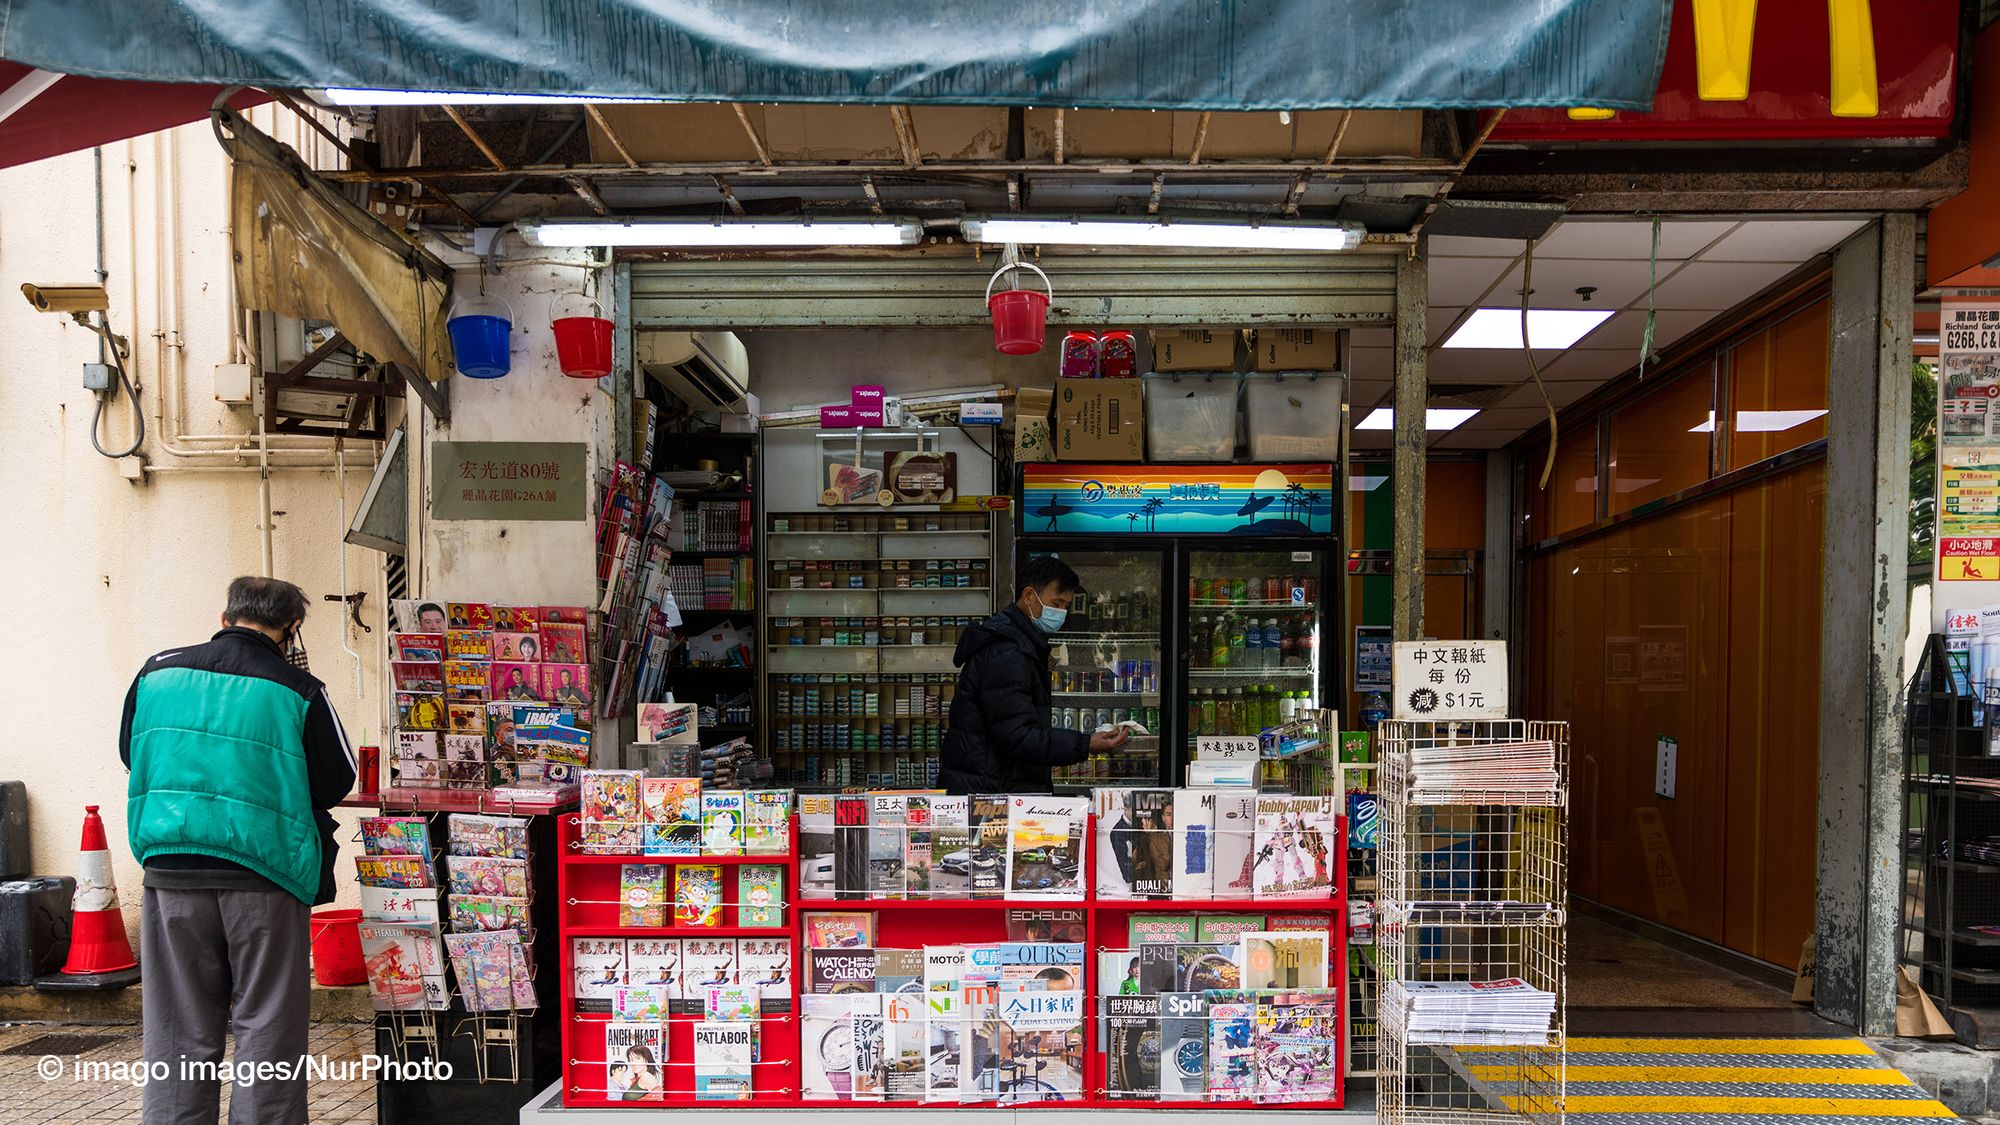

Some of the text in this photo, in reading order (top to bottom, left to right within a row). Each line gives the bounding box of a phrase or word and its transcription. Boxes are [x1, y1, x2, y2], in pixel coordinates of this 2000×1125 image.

[1955, 311, 2000, 321] 麗晶花園
[1981, 332, 1988, 348] C
[1990, 332, 1997, 348] &
[459, 460, 561, 481] 宏光道80號
[1949, 540, 1993, 551] 小心地滑
[1948, 614, 1979, 628] 信報
[1413, 648, 1486, 664] 中文報紙
[1415, 692, 1485, 709] 減 $1元
[399, 734, 424, 742] MIX
[401, 747, 414, 759] 18
[648, 782, 678, 793] 老夫子
[835, 799, 866, 825] HiFi
[1011, 910, 1082, 921] ECHELON
[374, 928, 402, 937] HEALTH
[576, 941, 623, 955] 龍虎門
[631, 941, 678, 955] 龍虎門
[686, 941, 734, 955] 龍虎門
[742, 941, 789, 955] 龍虎門
[1018, 945, 1067, 964] OURS
[815, 957, 857, 968] WATCH
[1004, 997, 1074, 1022] 今日家居
[1110, 1018, 1122, 1028] 100
[607, 1029, 633, 1046] ANGEL
[696, 1031, 748, 1045] PATLABOR
